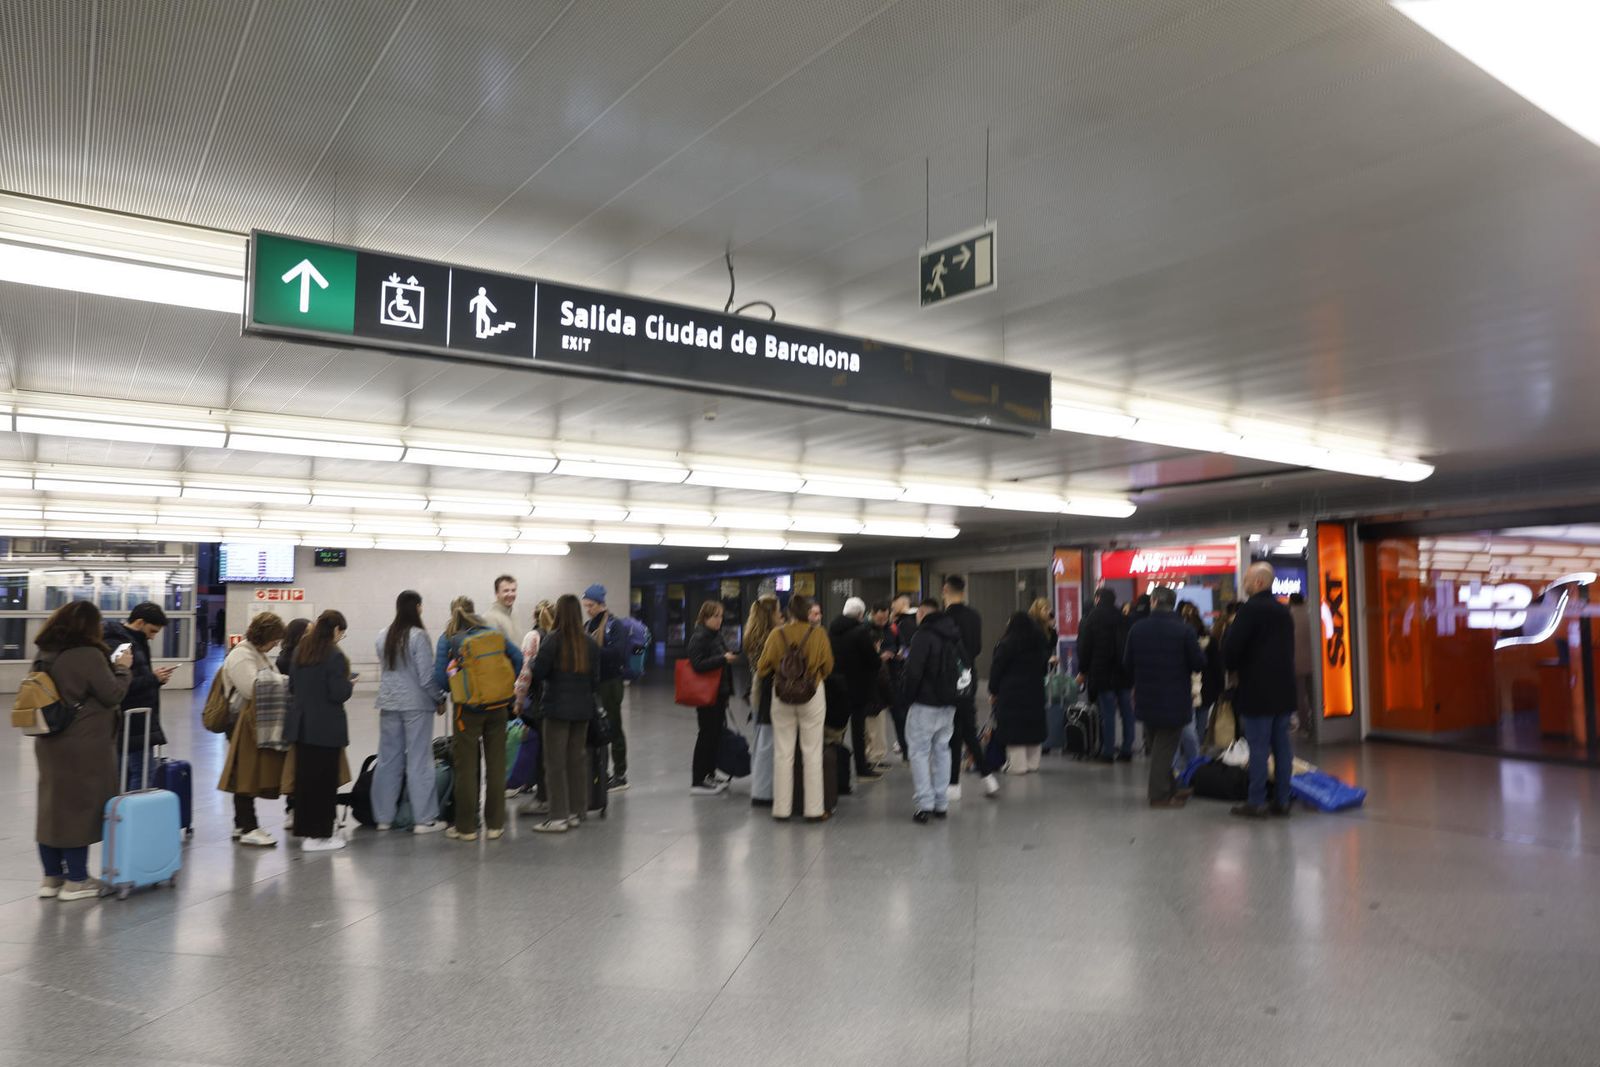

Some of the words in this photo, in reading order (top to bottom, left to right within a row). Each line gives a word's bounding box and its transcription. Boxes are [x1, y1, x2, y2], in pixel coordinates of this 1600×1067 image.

[560, 300, 637, 337] Salida
[645, 314, 723, 350] Ciudad
[730, 329, 758, 356] de
[764, 334, 861, 373] Barcelona
[561, 335, 591, 352] EXIT
[1325, 570, 1346, 668] SIXT
